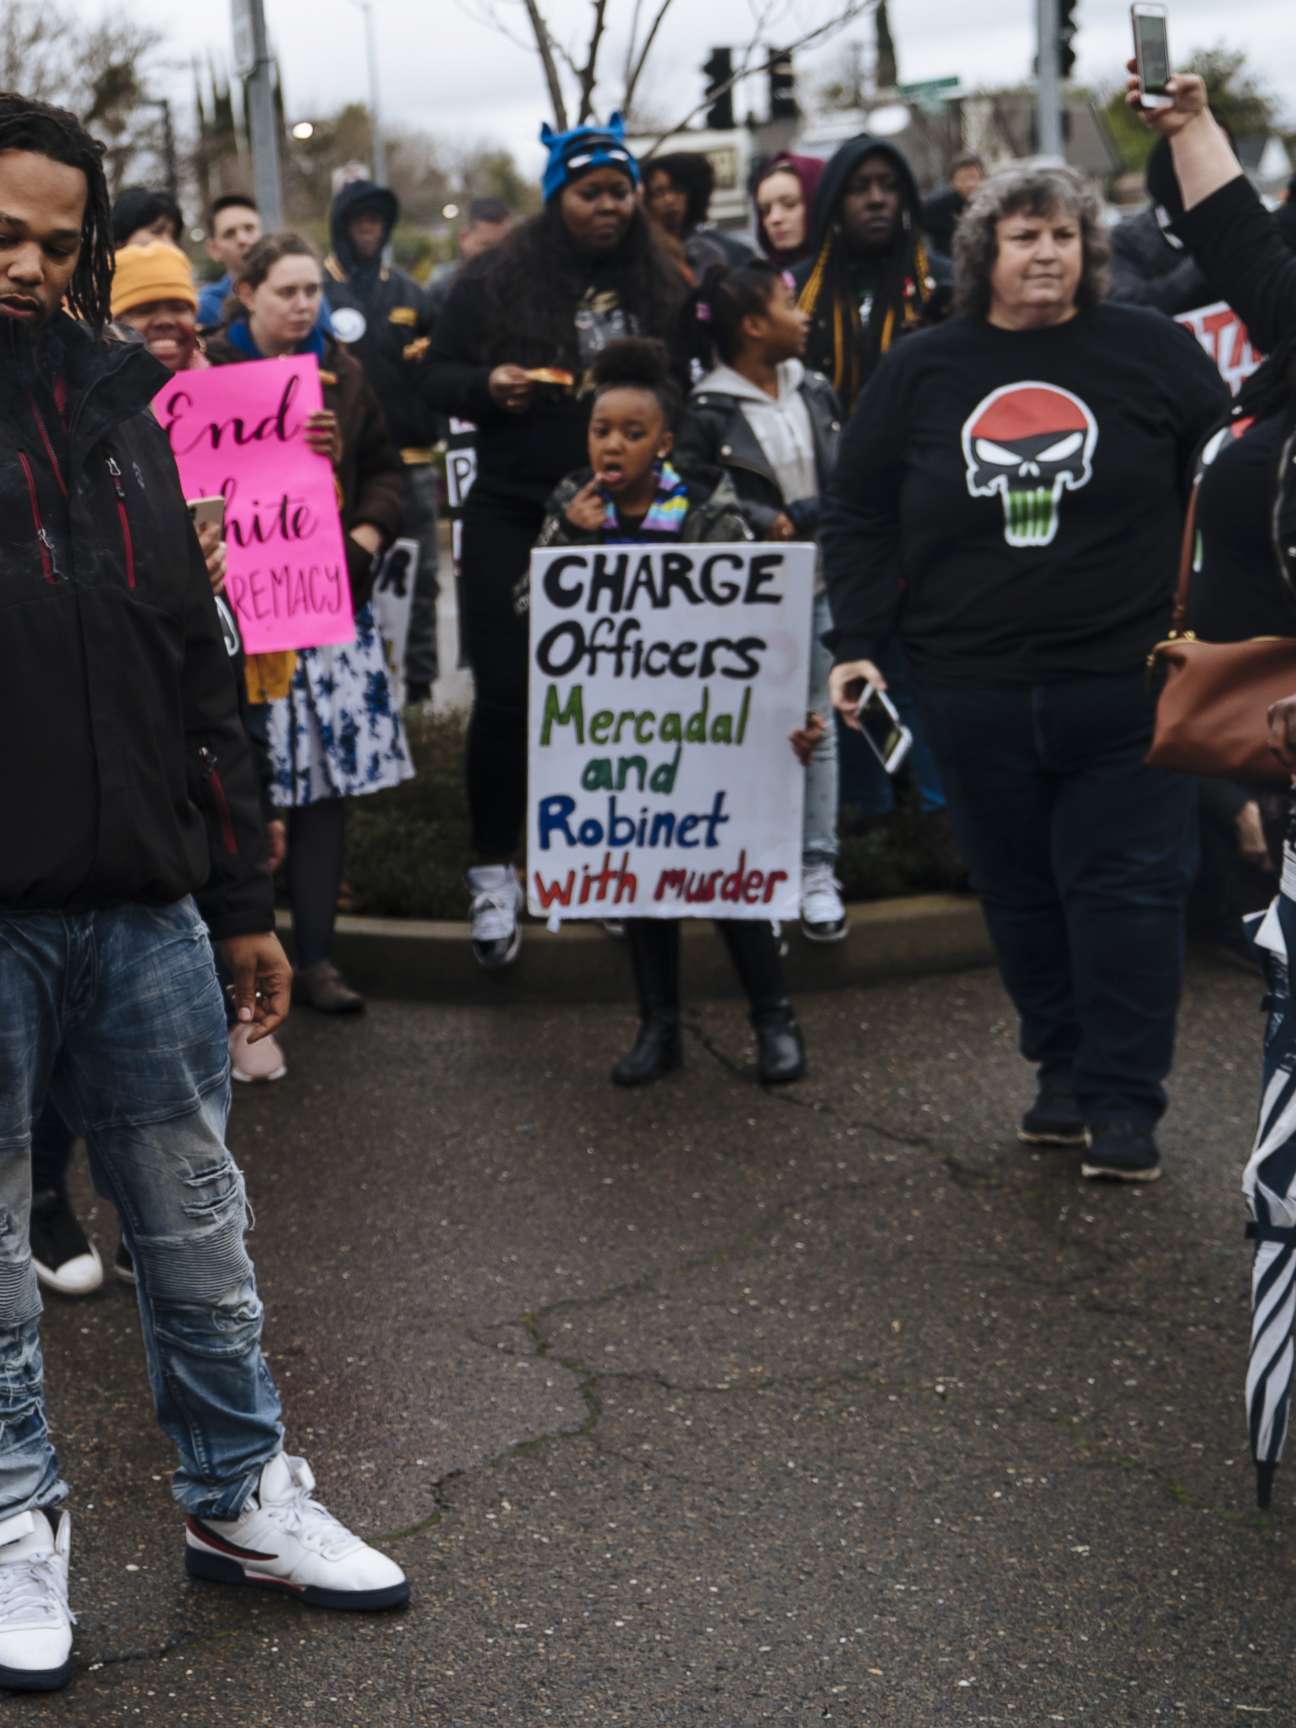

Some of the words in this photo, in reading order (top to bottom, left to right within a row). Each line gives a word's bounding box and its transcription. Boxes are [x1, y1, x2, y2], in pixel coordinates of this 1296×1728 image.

[164, 374, 306, 456] End
[199, 477, 319, 549] hite
[542, 552, 785, 615] CHARGE
[536, 617, 768, 680] Officers
[538, 683, 753, 748] Mercadal
[580, 740, 683, 796] and
[537, 789, 731, 851] Robinet
[533, 851, 638, 910] with
[654, 848, 789, 905] murder
